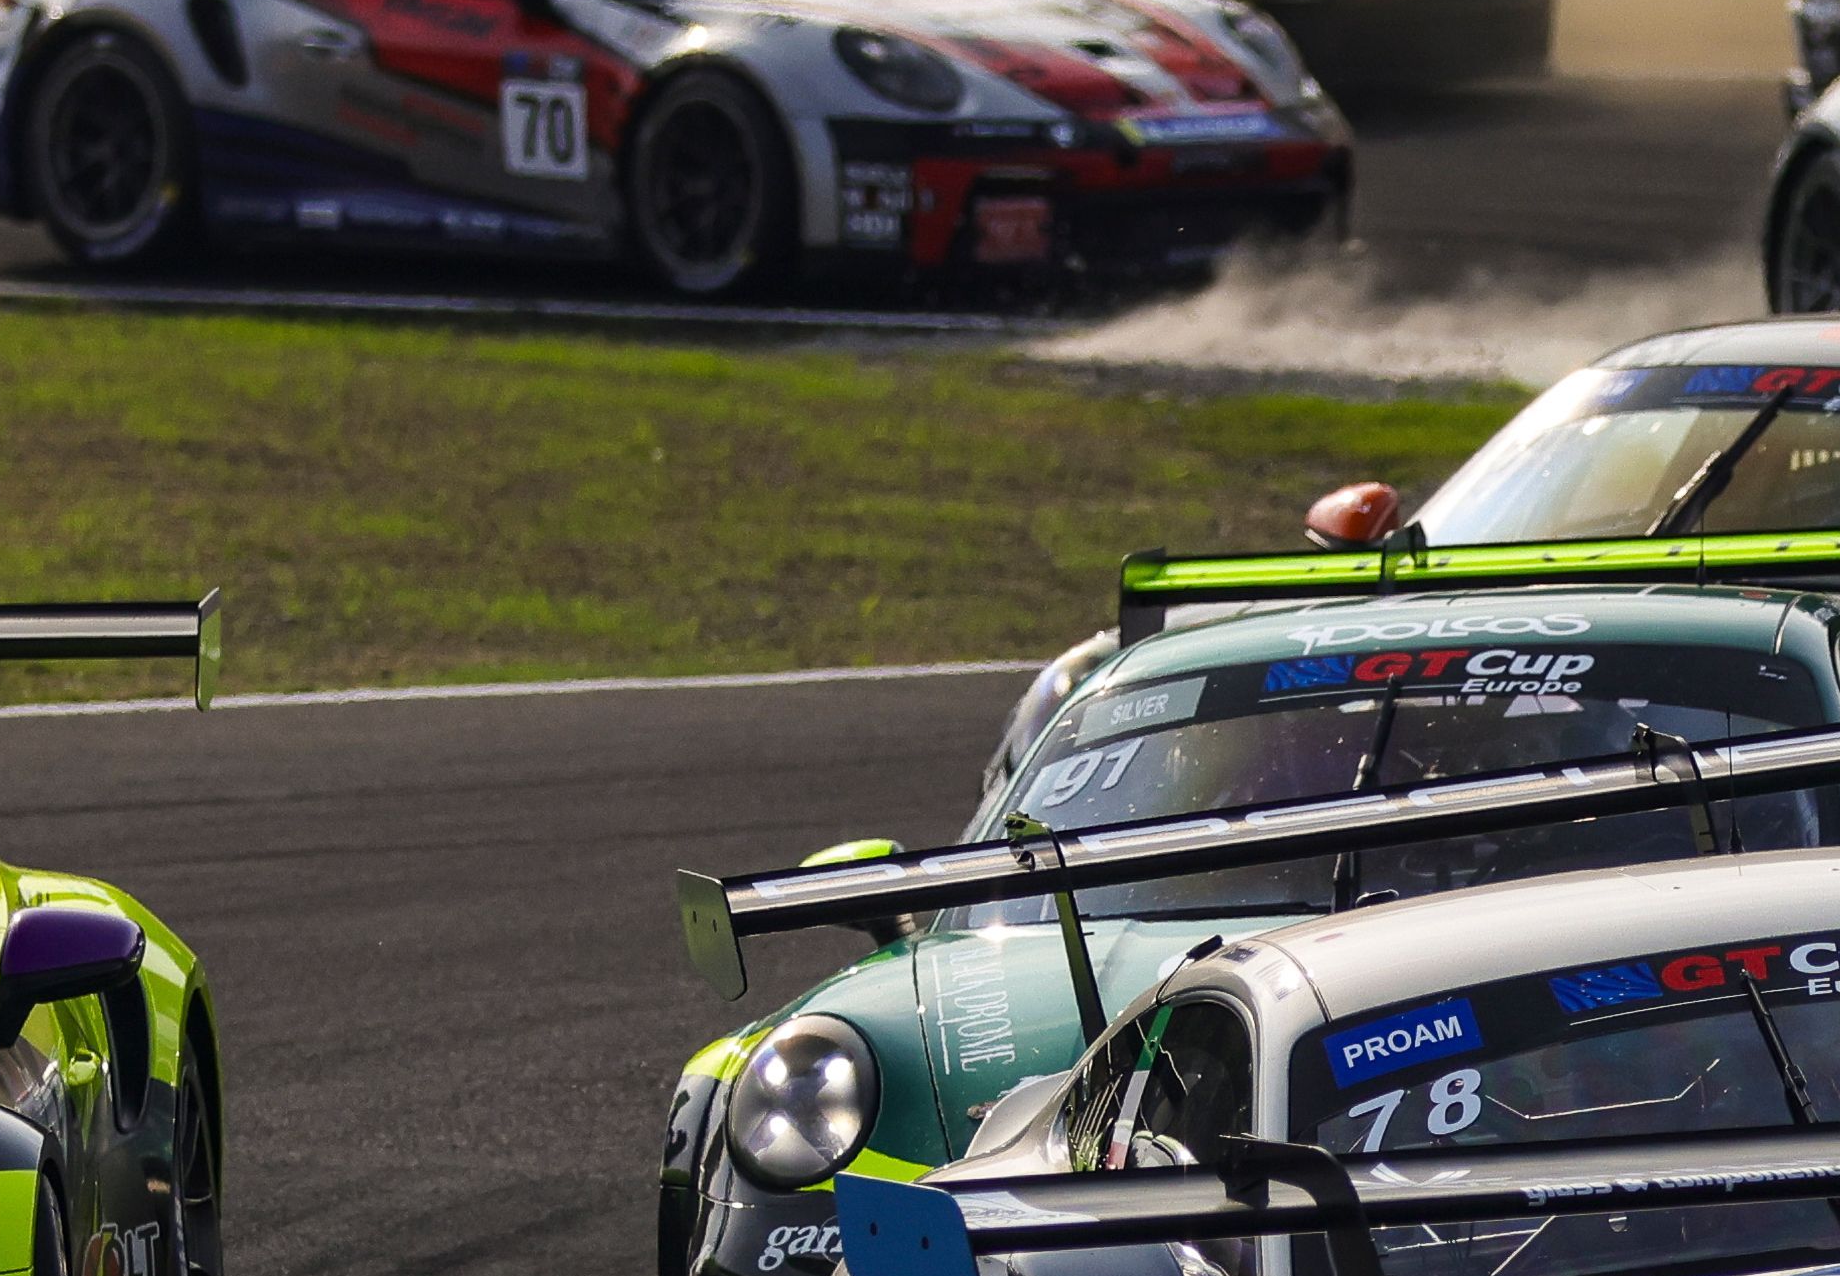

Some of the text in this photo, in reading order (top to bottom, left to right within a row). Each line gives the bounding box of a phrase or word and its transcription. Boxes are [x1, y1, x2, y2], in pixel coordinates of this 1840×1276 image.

[515, 92, 576, 166] 70
[1355, 648, 1595, 682] GT Cup
[1460, 677, 1582, 697] Europe
[1108, 691, 1169, 726] SILVER
[1041, 737, 1145, 808] 91
[1660, 945, 1781, 993] GT
[1342, 1014, 1465, 1070] PROAM
[1348, 1067, 1483, 1154] 78
